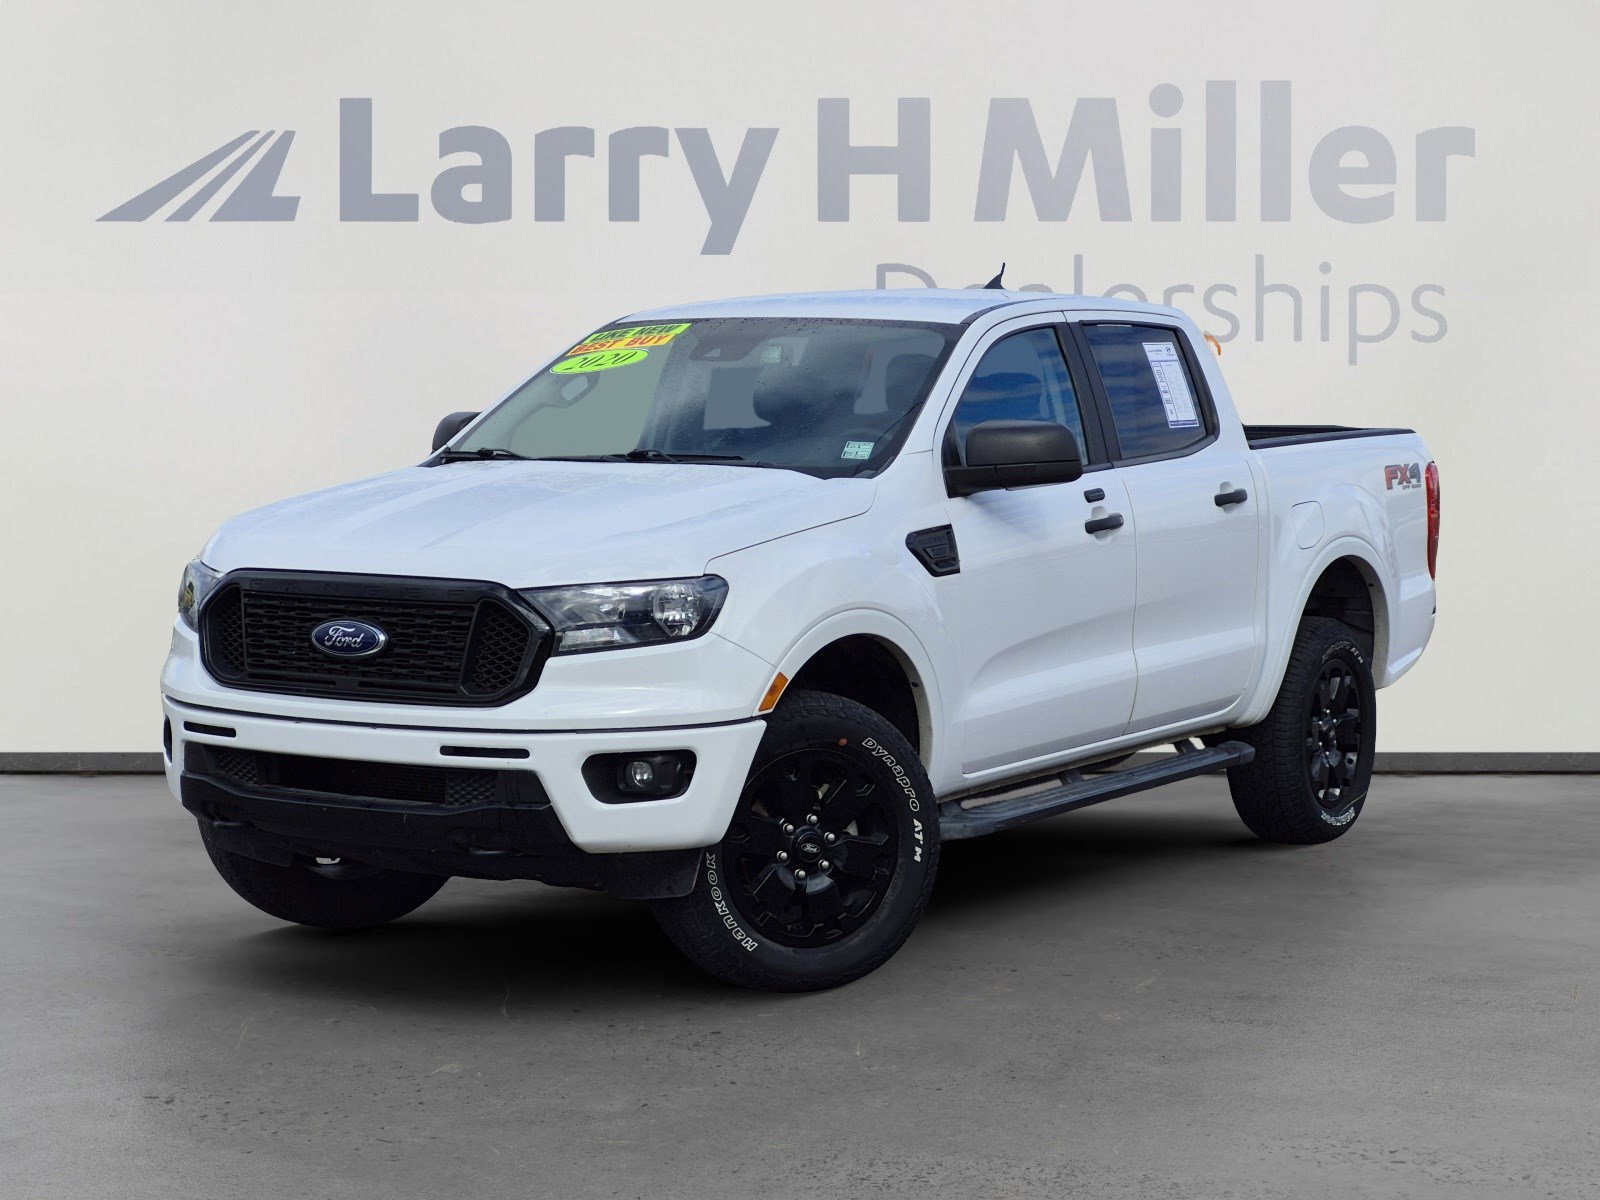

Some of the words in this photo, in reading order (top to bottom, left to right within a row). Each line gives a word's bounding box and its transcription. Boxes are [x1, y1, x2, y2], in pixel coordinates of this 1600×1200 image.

[340, 98, 779, 255] Larry
[817, 98, 931, 222] H
[974, 80, 1476, 224] Miller
[631, 324, 682, 337] NEW
[570, 339, 625, 355] BEST
[623, 335, 670, 347] BUY
[561, 351, 638, 371] 2020
[1384, 463, 1421, 490] FX4
[324, 625, 365, 648] Ford
